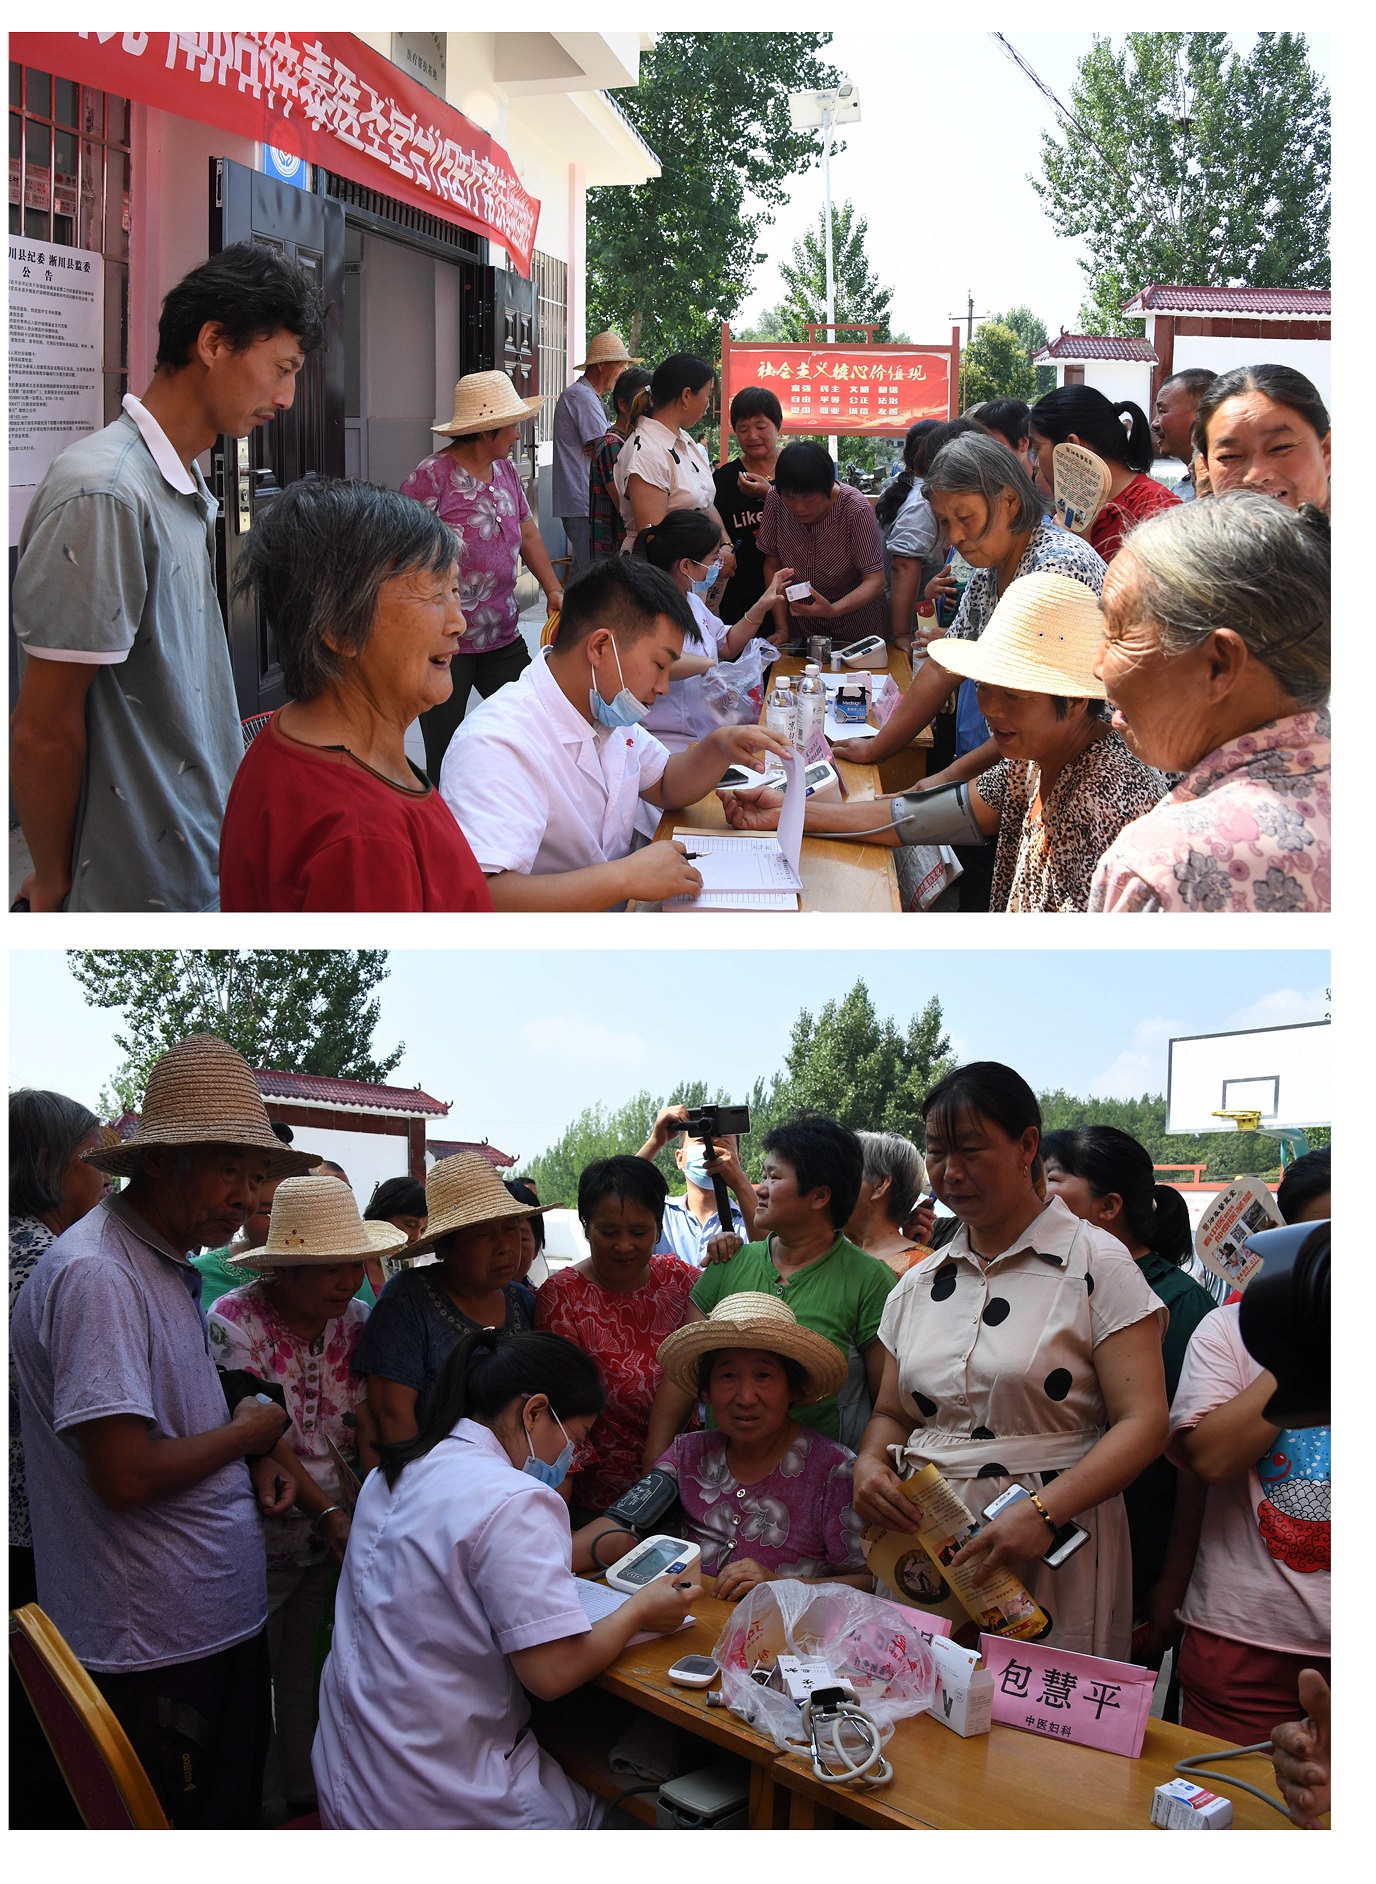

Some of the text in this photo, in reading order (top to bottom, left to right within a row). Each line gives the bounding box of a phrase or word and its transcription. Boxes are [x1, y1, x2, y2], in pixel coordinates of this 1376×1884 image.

[49, 254, 91, 273] 淅川县监委
[757, 360, 927, 382] 社会主义核心价值观
[791, 384, 899, 394] 富强 民主 文明 和谐
[791, 395, 899, 405] 自由 平等 公正 法治
[791, 406, 899, 416] 爱国 敬业 诚信 友善
[733, 510, 763, 529] Like
[997, 1657, 1122, 1720] 包慧平
[1025, 1715, 1072, 1738] 中医妇科
